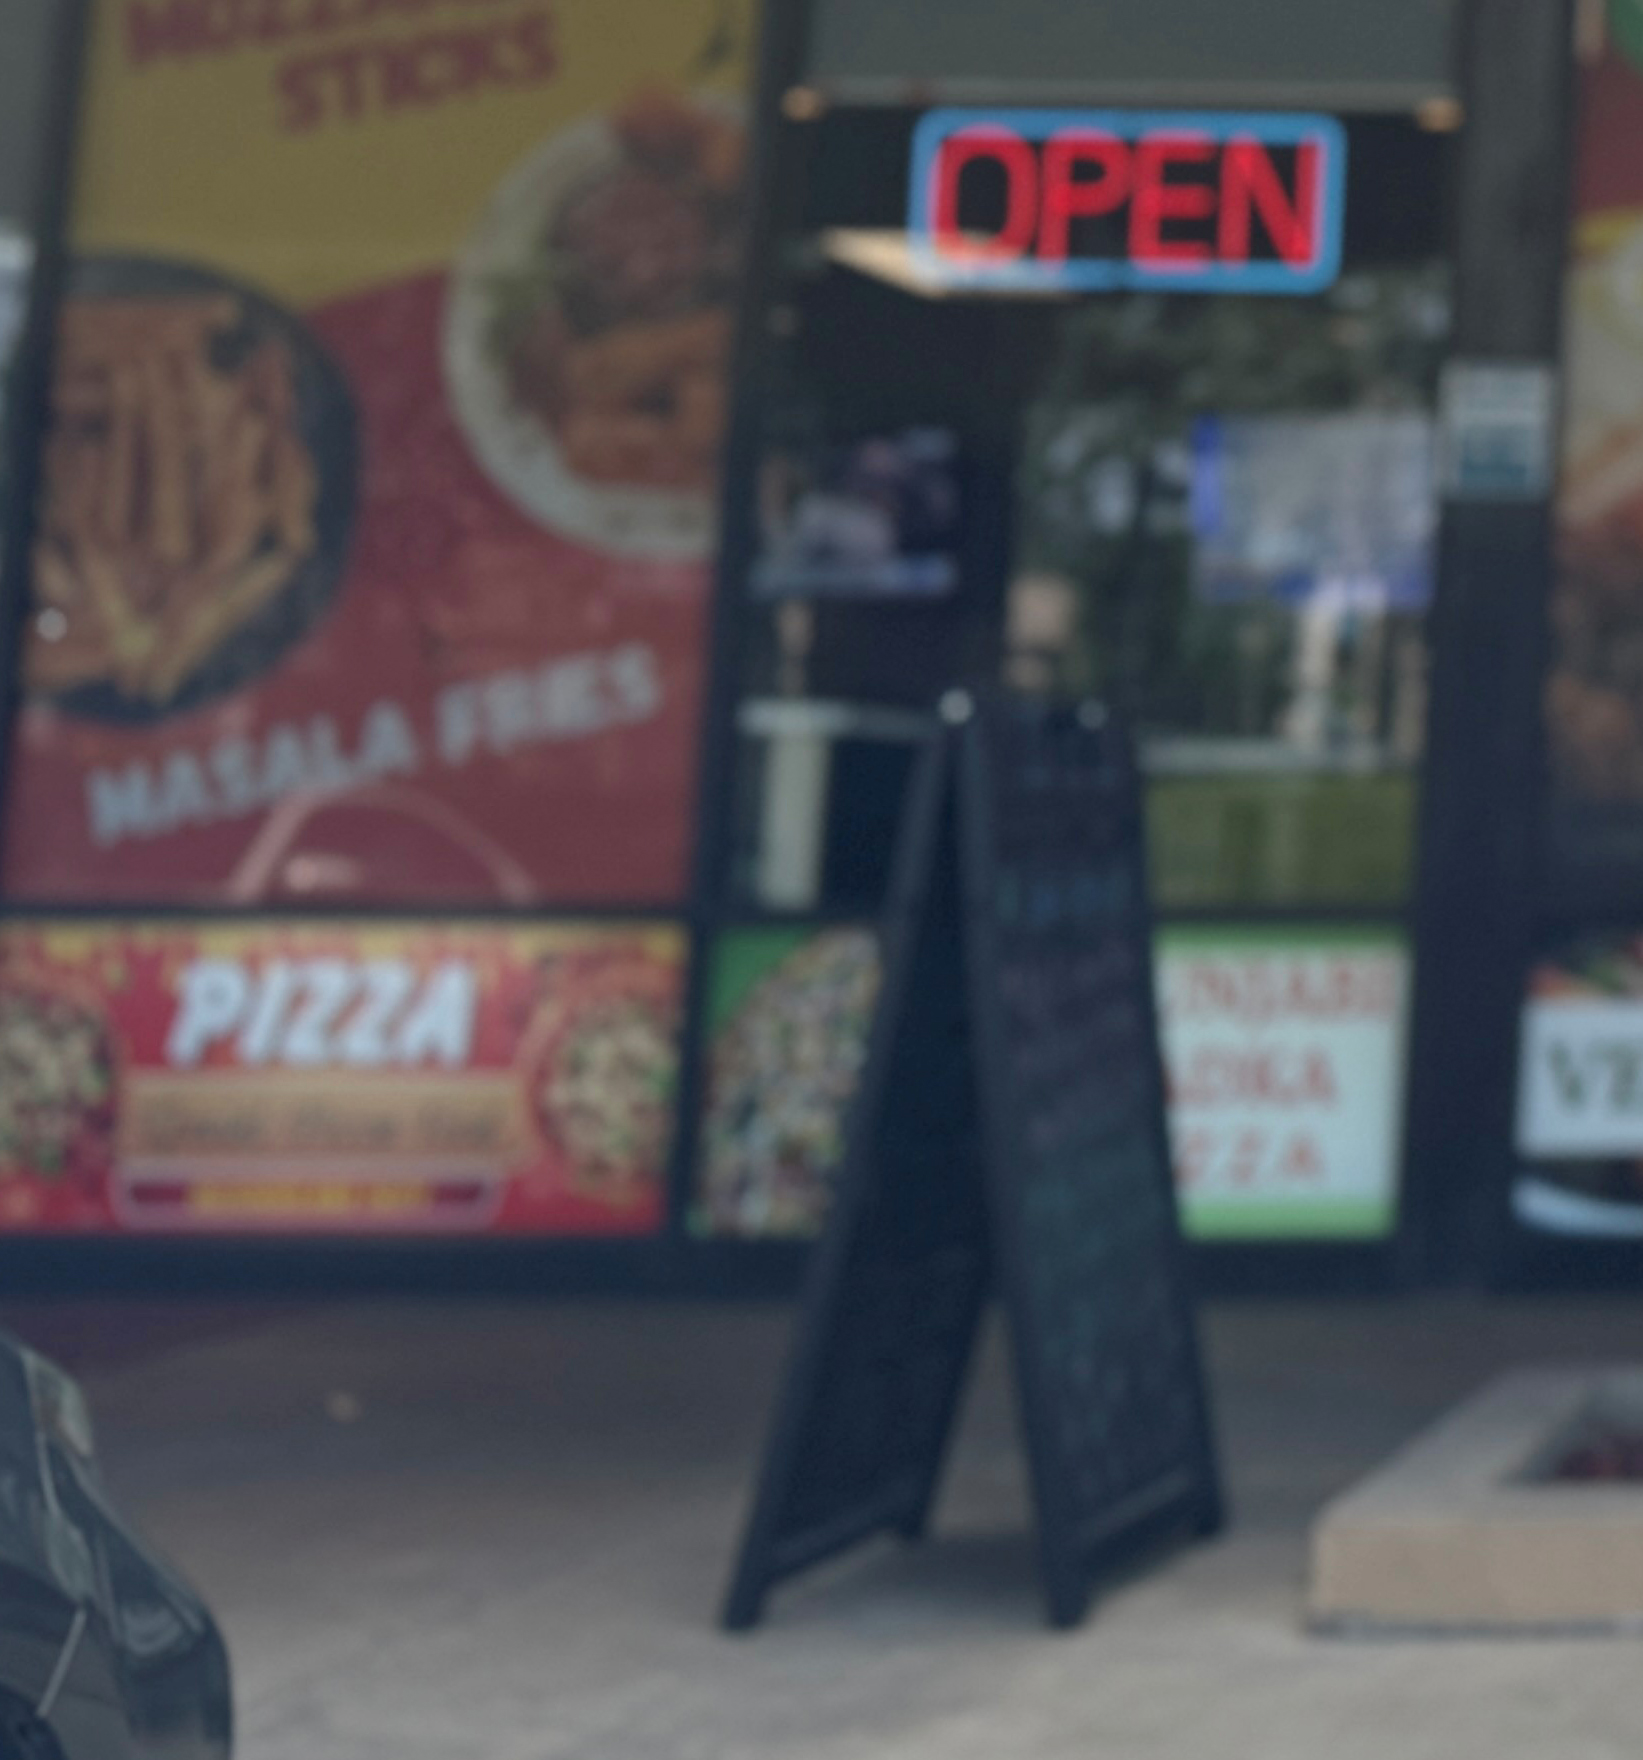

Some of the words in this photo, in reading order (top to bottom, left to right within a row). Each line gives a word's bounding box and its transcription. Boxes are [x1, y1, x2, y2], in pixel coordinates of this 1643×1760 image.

[272, 9, 560, 138] STICKS
[927, 120, 1329, 276] OPEN
[85, 697, 419, 845] MASALA
[431, 643, 667, 767] FRIES
[164, 954, 481, 1070] PIZZA
